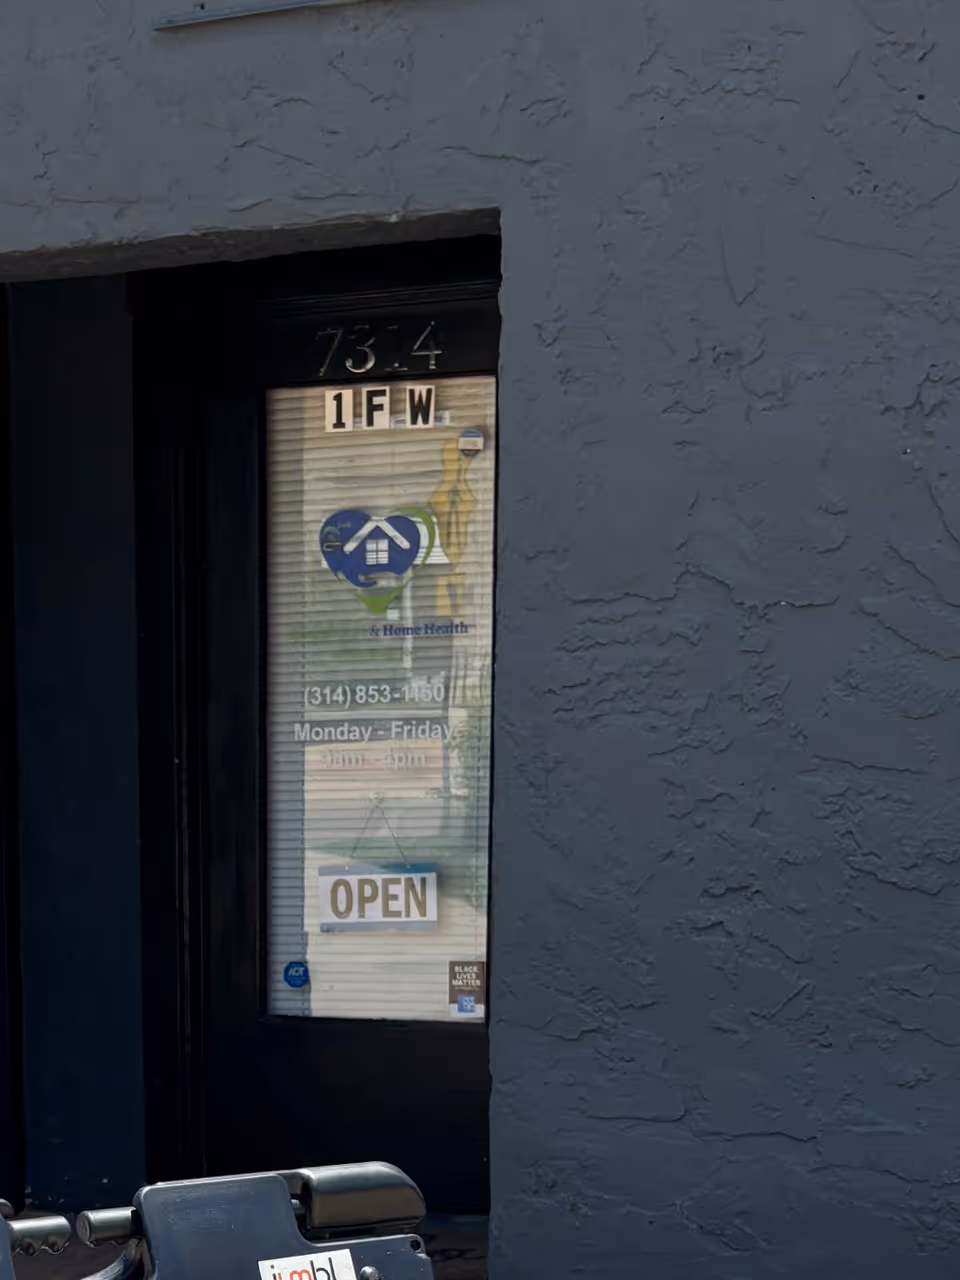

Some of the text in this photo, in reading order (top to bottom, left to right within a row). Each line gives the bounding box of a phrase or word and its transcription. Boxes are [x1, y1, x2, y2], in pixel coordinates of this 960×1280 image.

[383, 624, 421, 636] Home
[424, 620, 469, 634] Health
[304, 685, 351, 708] (314)
[294, 723, 373, 744] Monday
[391, 721, 454, 742] Friday
[330, 876, 428, 920] OPEN
[454, 965, 480, 973] BLACK
[456, 972, 477, 980] LIVES
